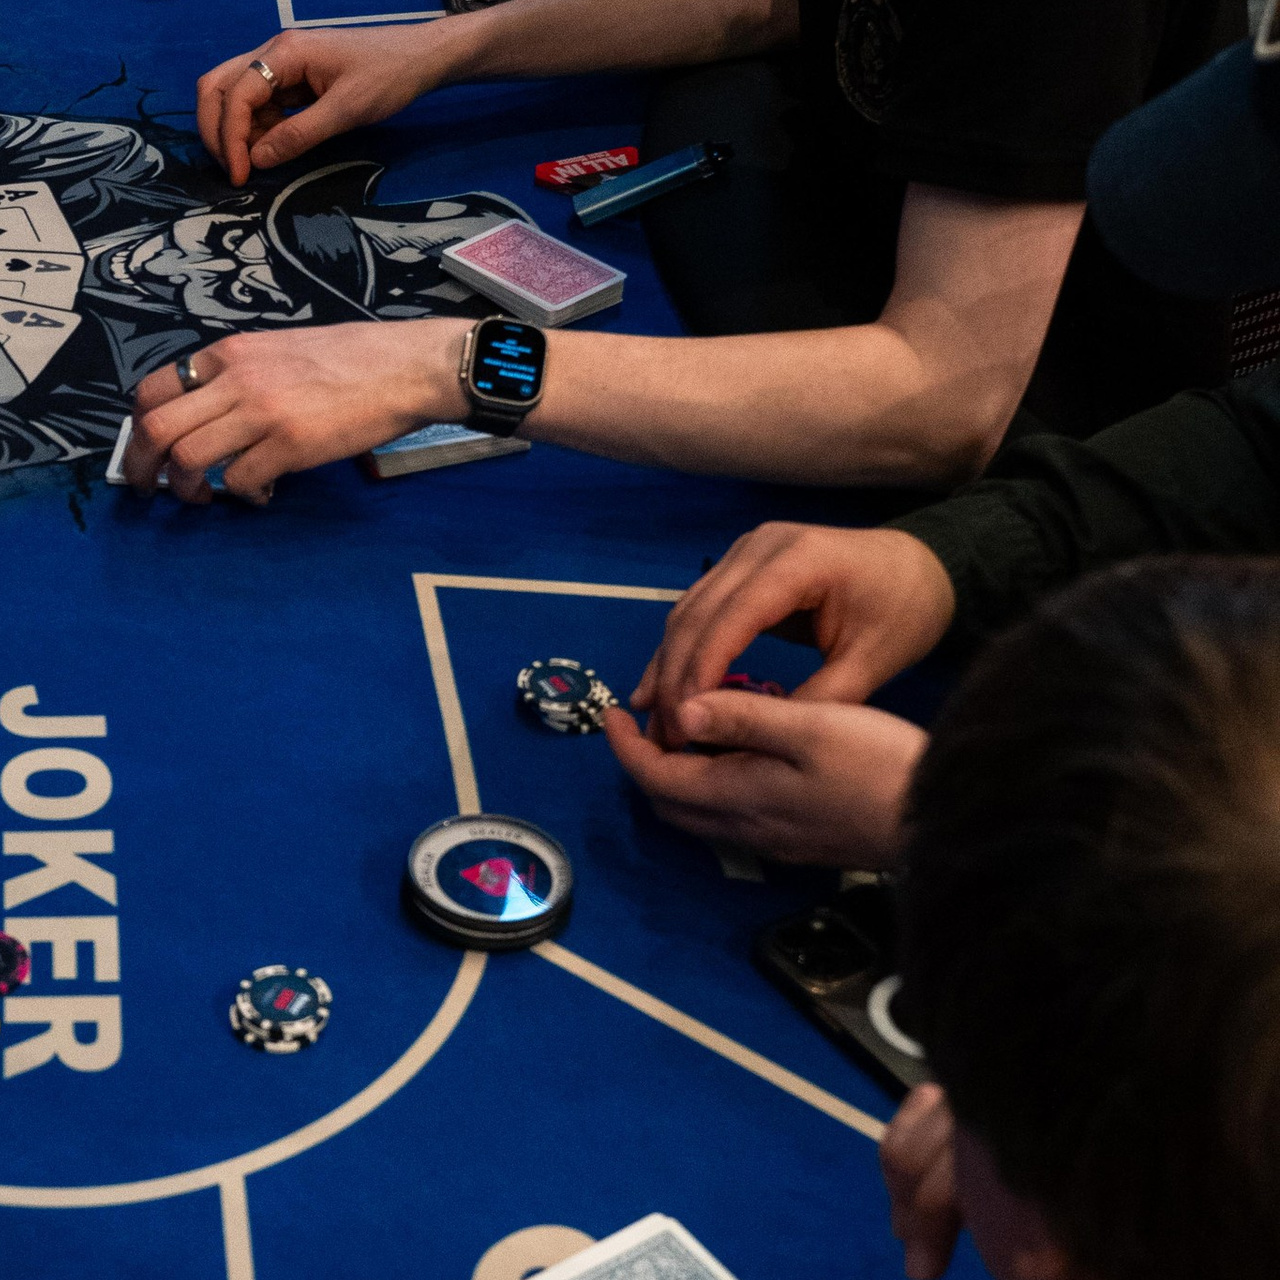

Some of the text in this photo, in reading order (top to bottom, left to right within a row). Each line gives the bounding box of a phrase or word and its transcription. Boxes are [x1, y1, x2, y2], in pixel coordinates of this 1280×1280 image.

[581, 153, 629, 172] ALL
[553, 163, 587, 179] IN
[4, 189, 39, 202] A
[35, 259, 72, 273] A
[23, 312, 66, 329] A
